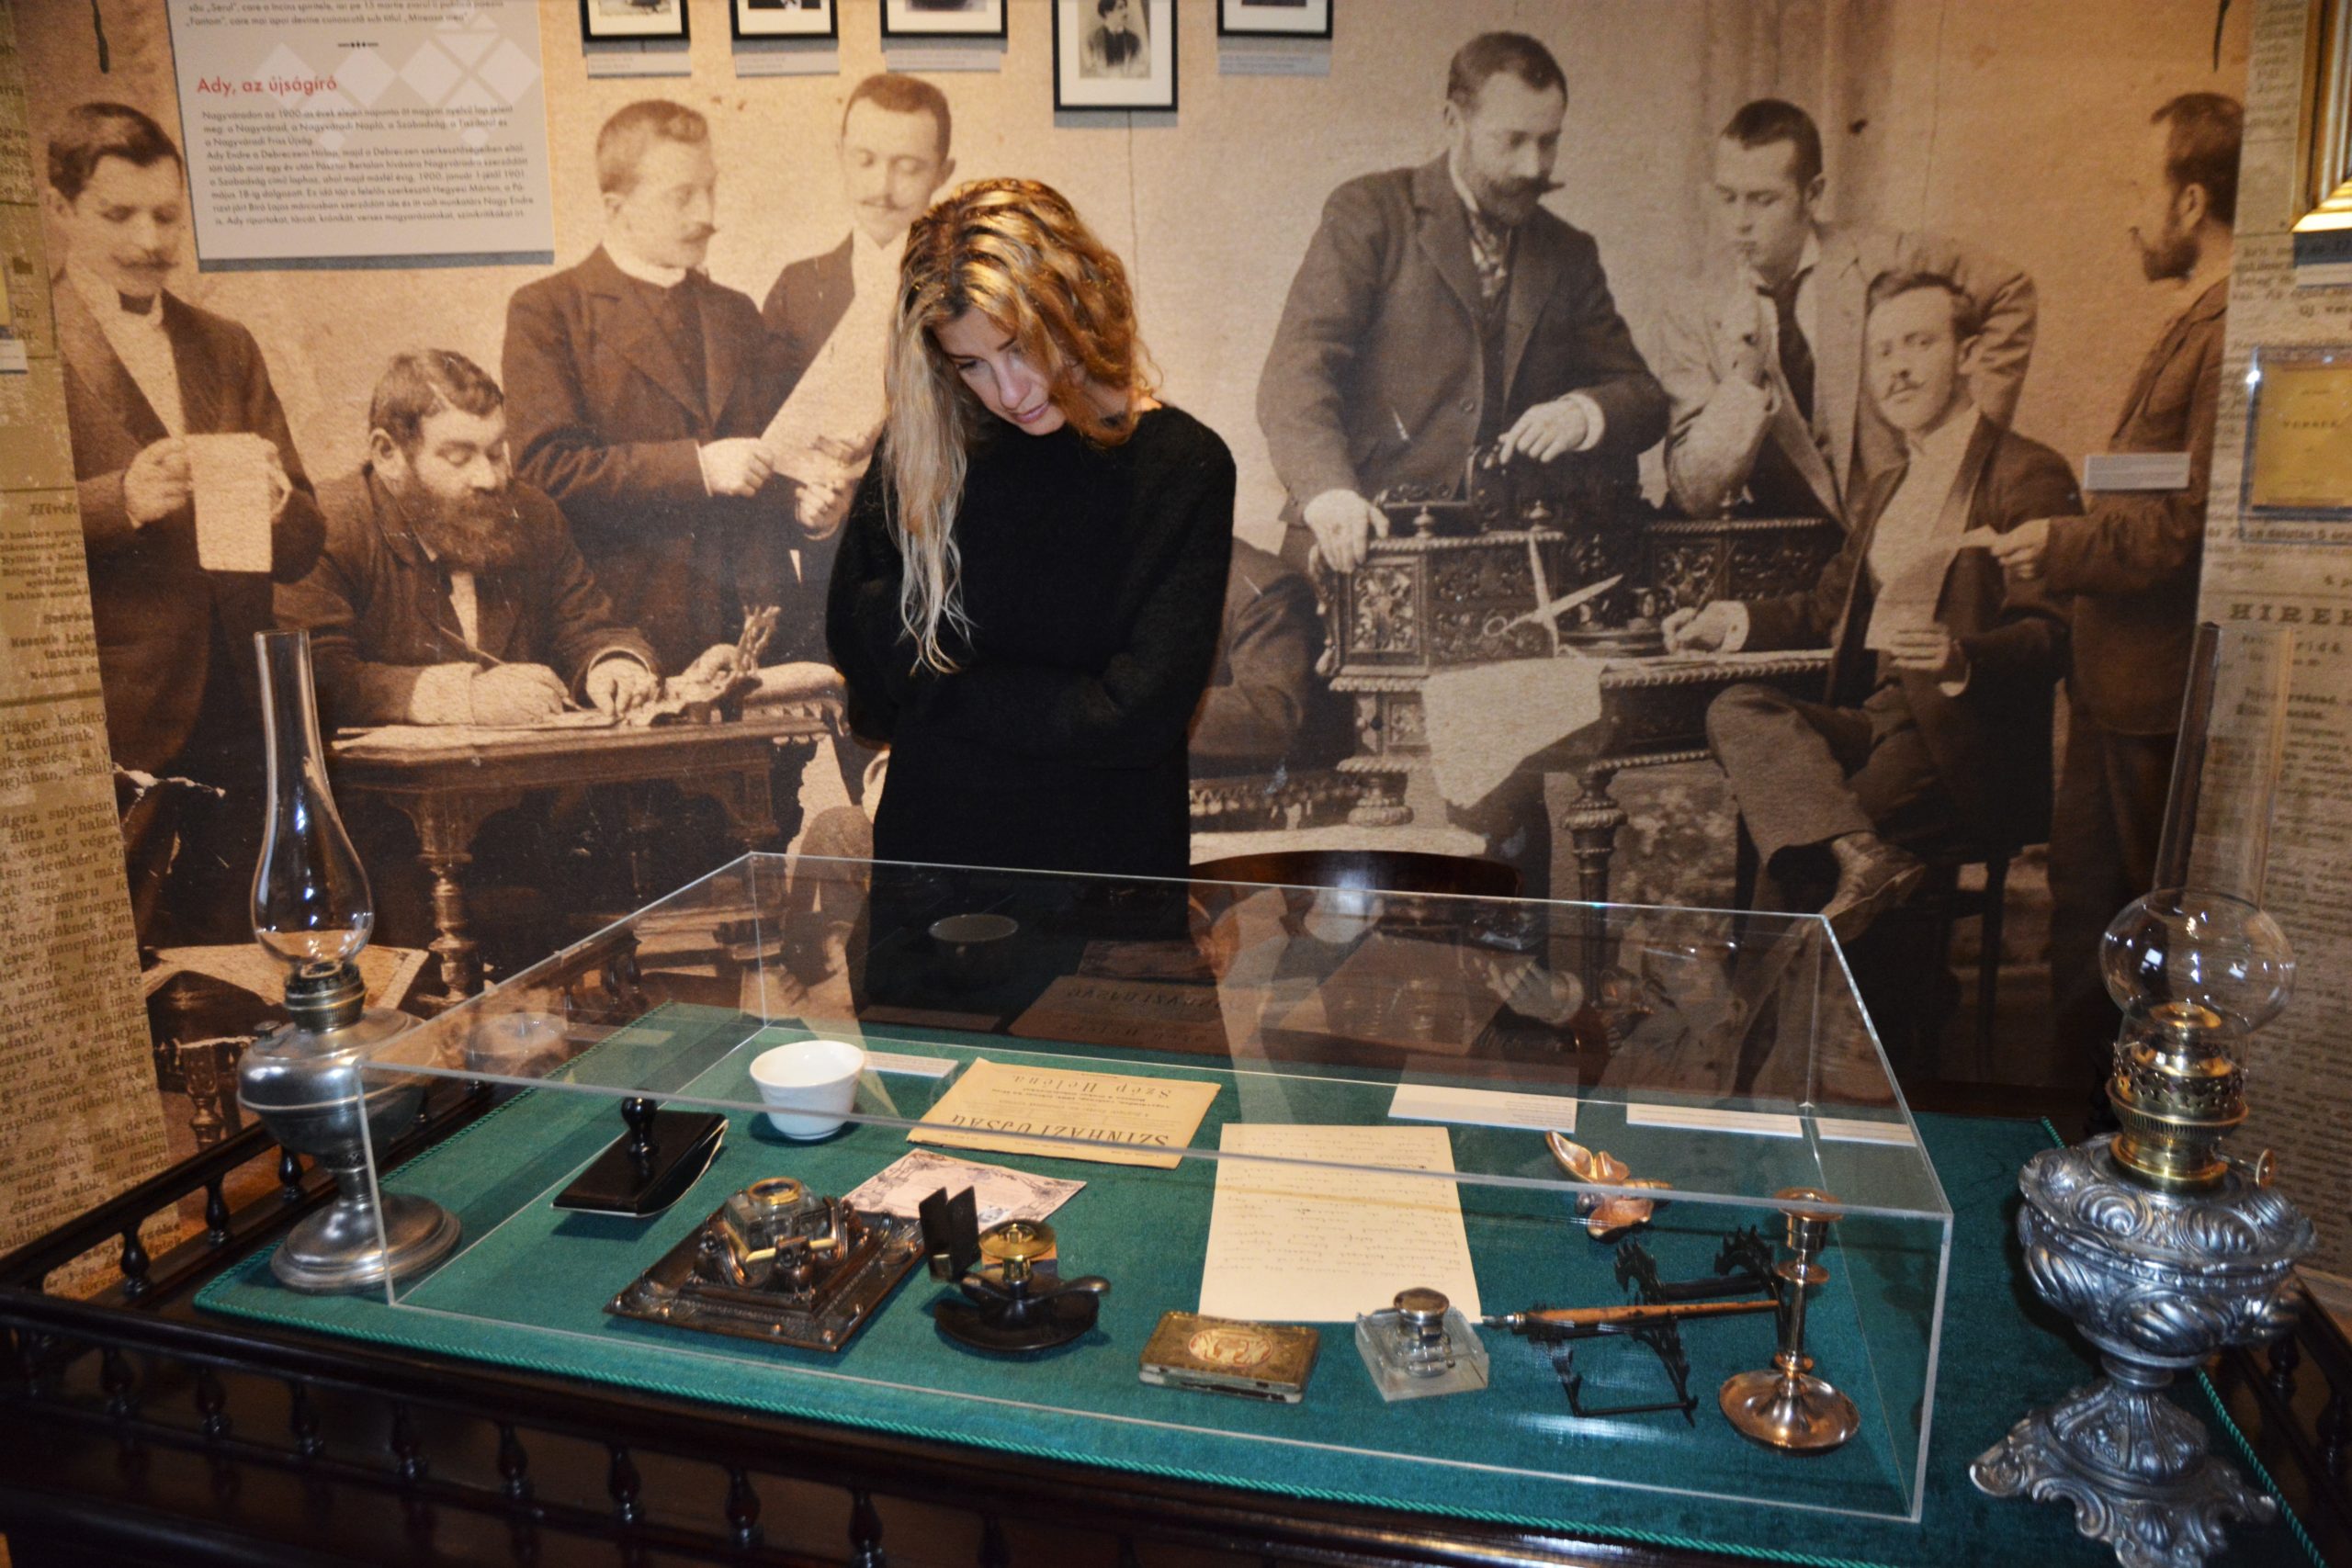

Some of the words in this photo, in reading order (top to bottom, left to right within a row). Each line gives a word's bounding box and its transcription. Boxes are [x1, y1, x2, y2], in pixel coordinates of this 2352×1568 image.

[197, 76, 236, 97] Ady,
[242, 83, 263, 93] az
[268, 75, 337, 96] újságíró
[207, 150, 224, 162] Ady
[226, 150, 250, 159] Endre
